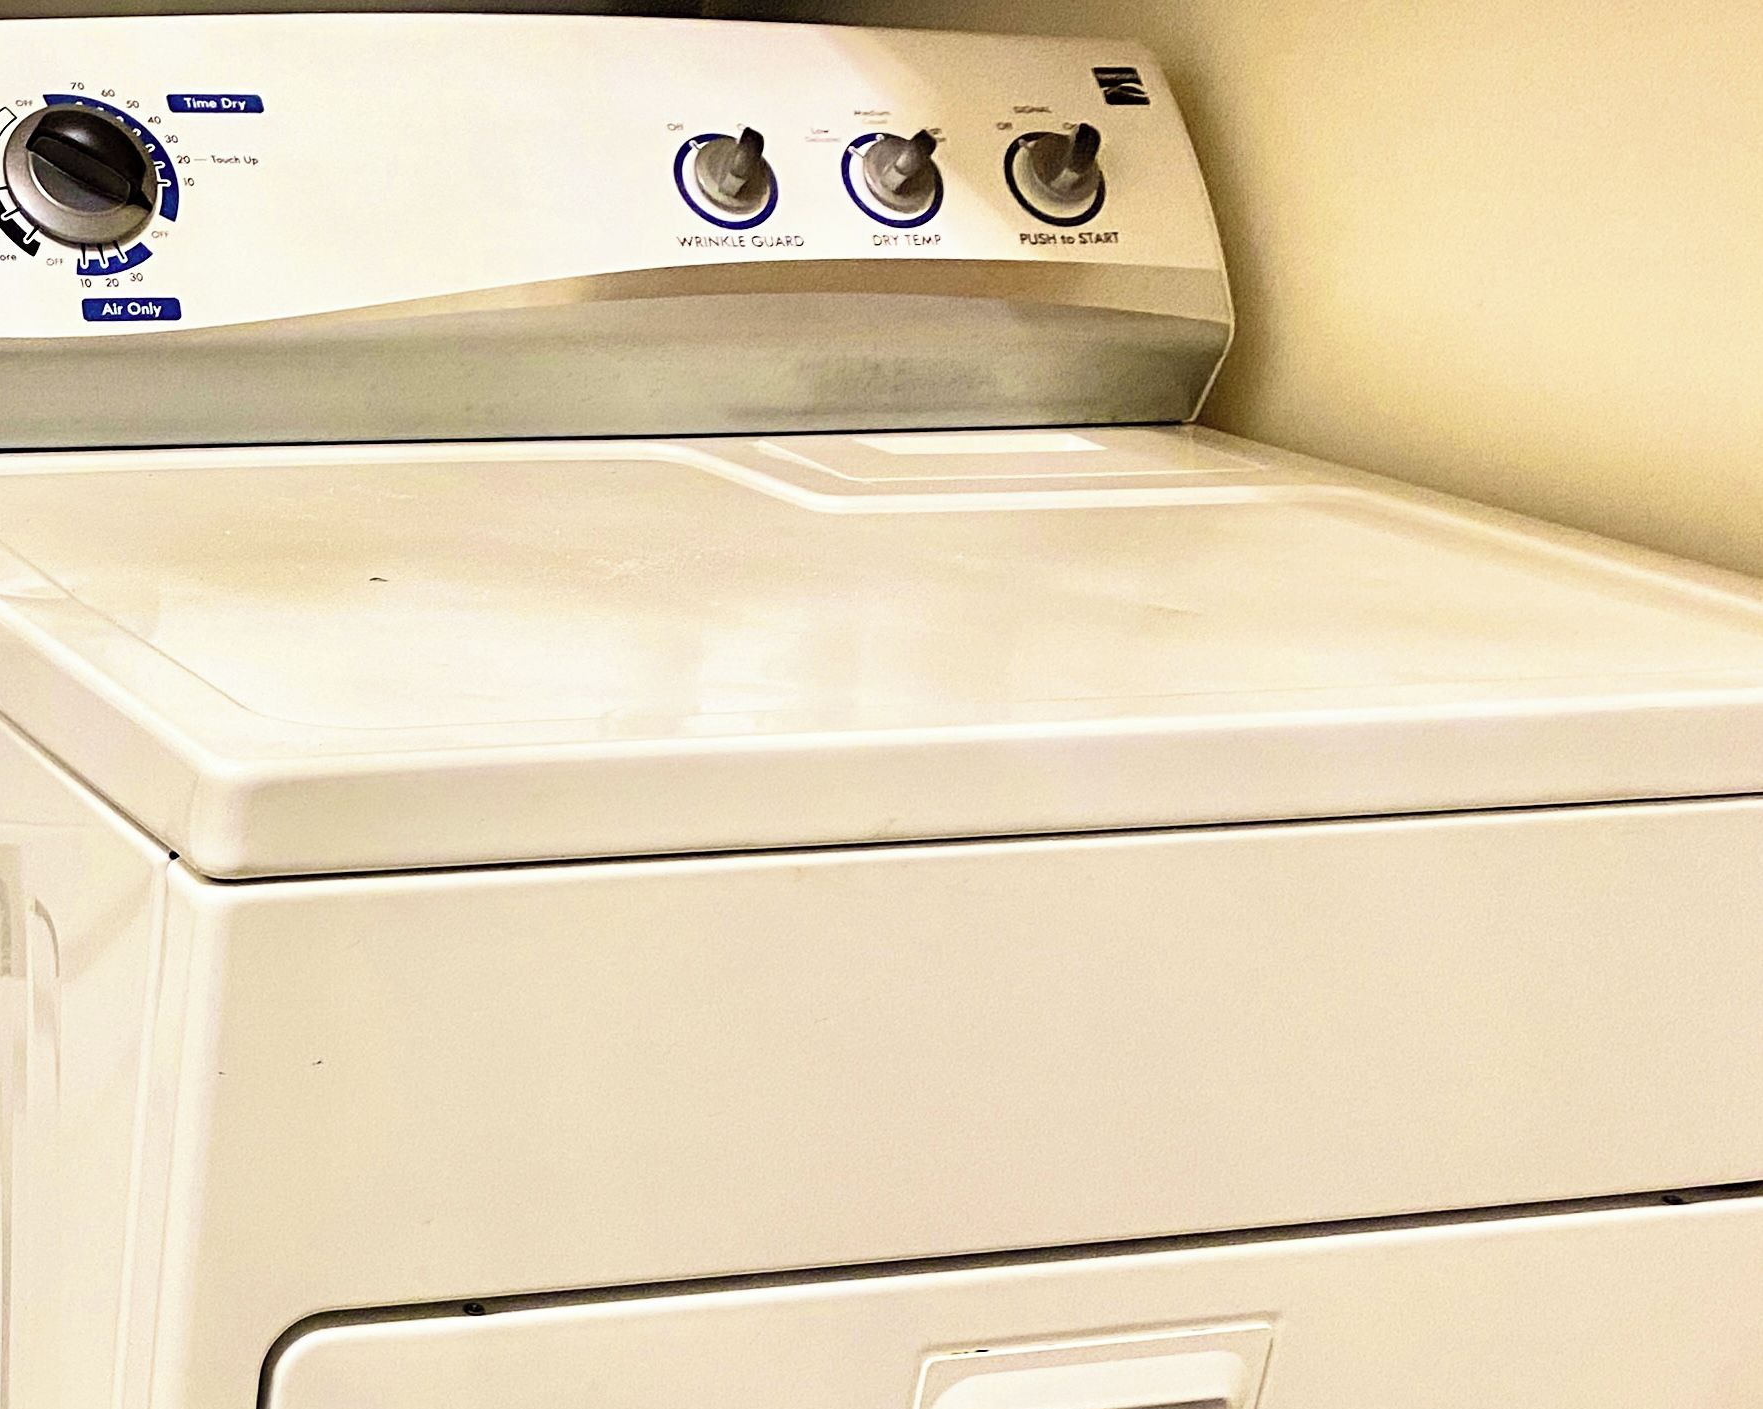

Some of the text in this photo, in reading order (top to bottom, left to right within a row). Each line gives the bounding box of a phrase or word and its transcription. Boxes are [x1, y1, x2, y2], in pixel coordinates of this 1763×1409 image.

[70, 82, 85, 91] 70
[101, 89, 116, 98] 60
[126, 100, 140, 109] 50
[183, 97, 247, 111] Time Dry
[147, 116, 162, 125] 40
[164, 135, 179, 144] 30
[176, 156, 191, 164] 20
[210, 155, 259, 166] Touch Up
[182, 177, 195, 187] 10
[151, 231, 170, 239] OFF
[1019, 232, 1120, 245] PUSH to START
[676, 235, 805, 248] WRINKLE GUARD
[872, 234, 942, 246] DRY TEMP
[46, 258, 64, 267] OFF
[129, 273, 144, 282] 30
[80, 278, 93, 288] 10
[106, 278, 120, 288] 20
[101, 302, 162, 317] Air Only
